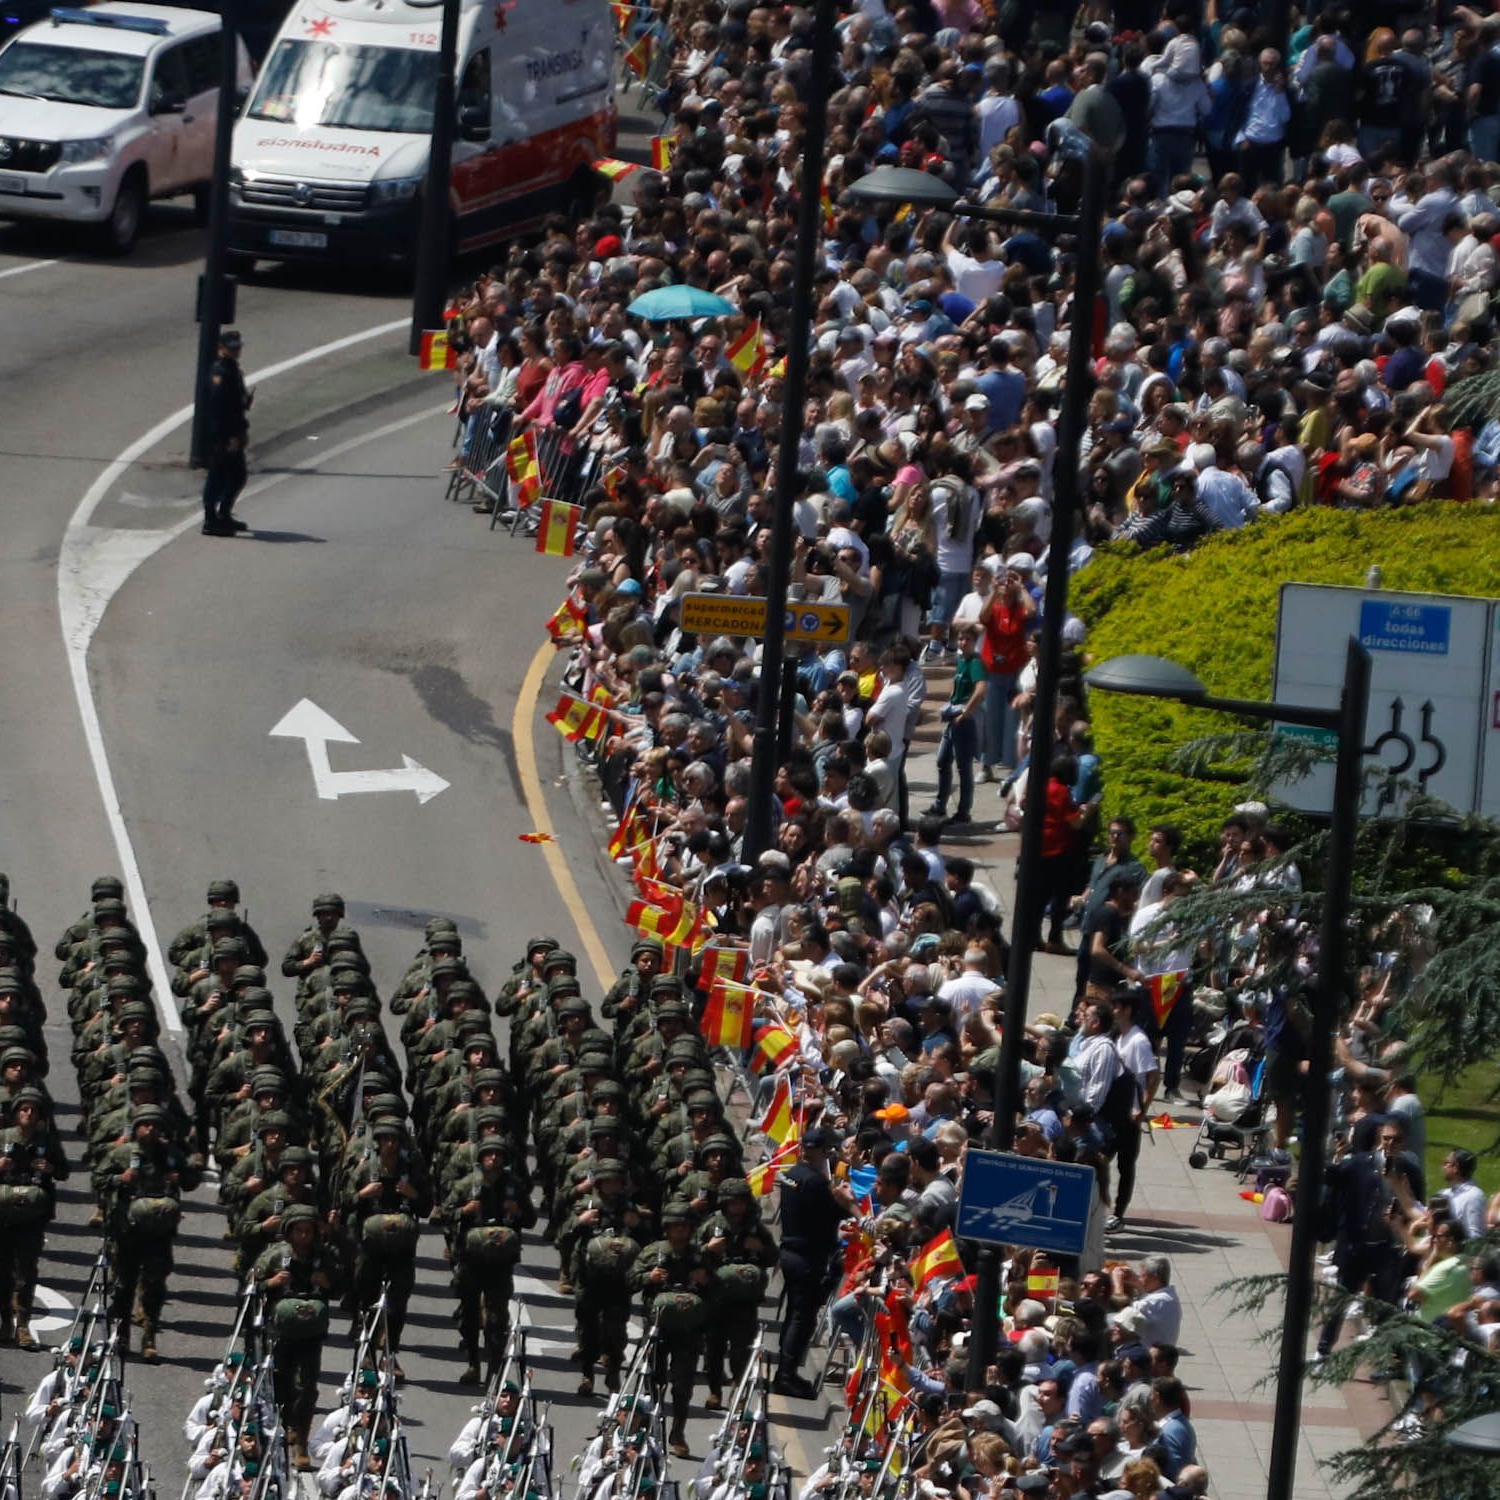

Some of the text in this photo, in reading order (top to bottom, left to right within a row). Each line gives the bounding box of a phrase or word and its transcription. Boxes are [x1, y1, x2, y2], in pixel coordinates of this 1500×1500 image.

[409, 31, 437, 46] 112
[526, 49, 583, 80] TRANSINSA
[686, 602, 765, 615] supermercad
[1384, 620, 1426, 635] todas
[1362, 635, 1445, 651] direcciones
